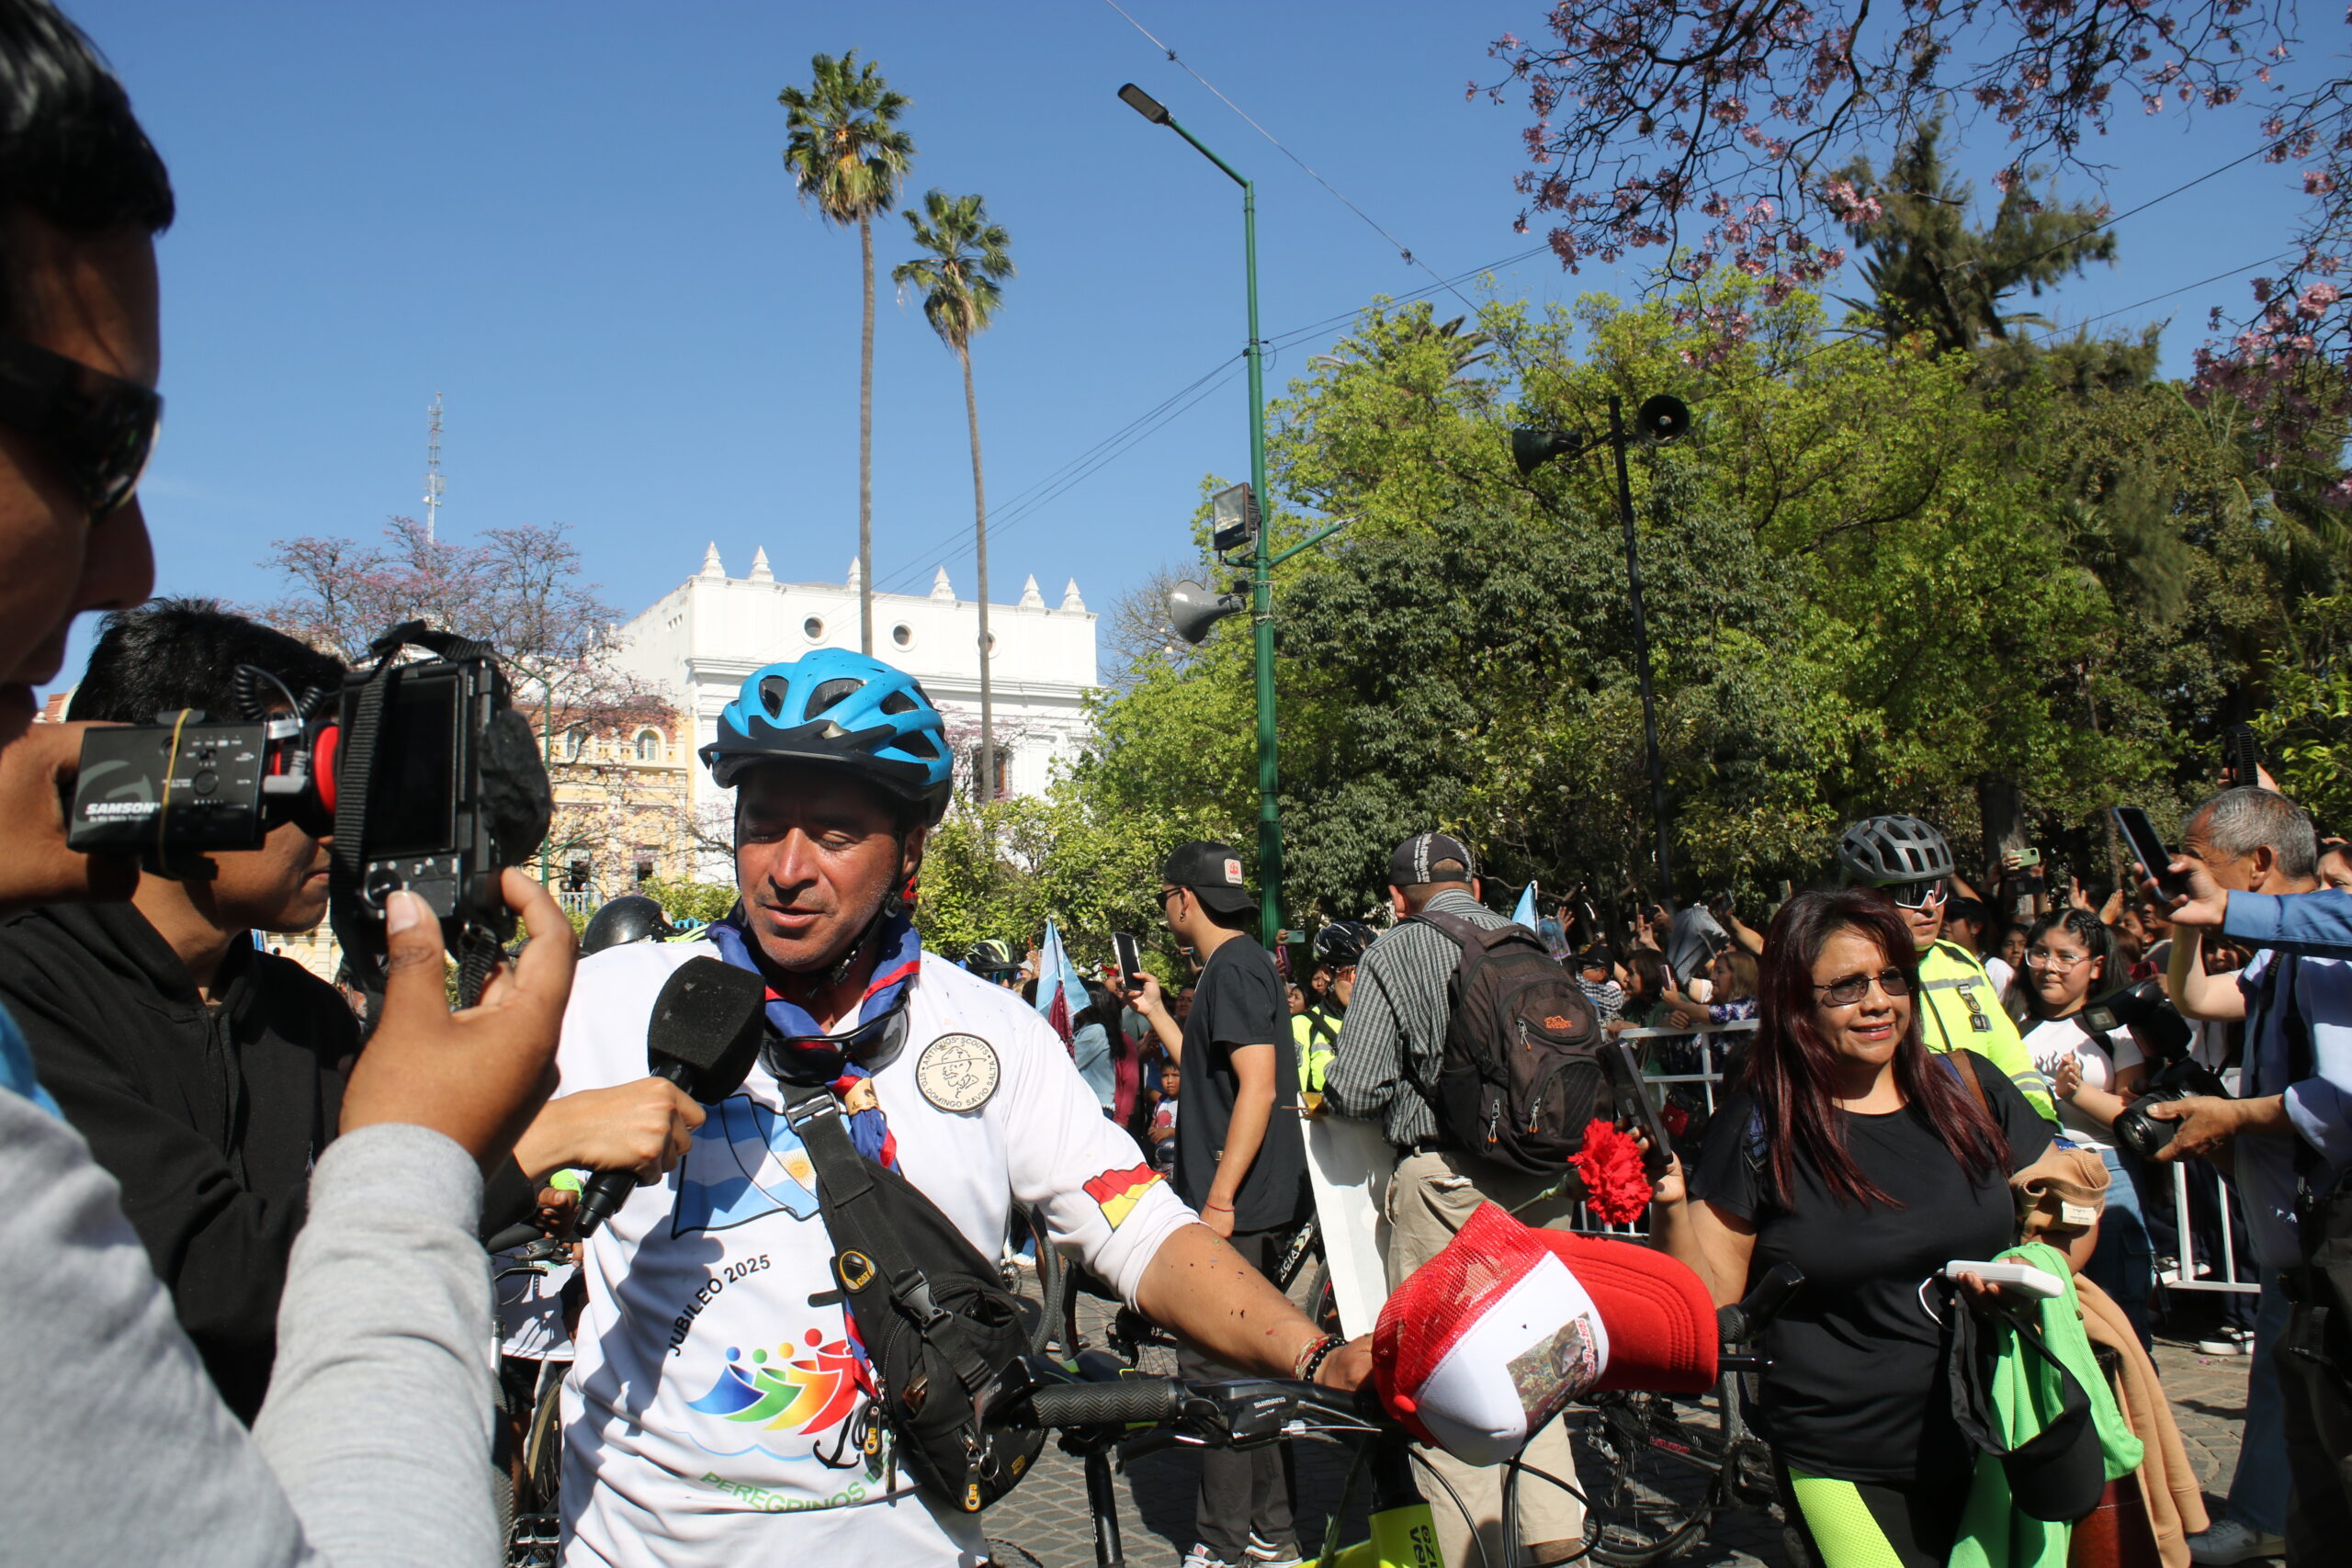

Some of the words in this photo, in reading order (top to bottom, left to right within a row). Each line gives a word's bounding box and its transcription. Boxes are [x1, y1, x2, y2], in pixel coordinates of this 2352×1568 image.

[85, 801, 155, 816] SAMSON
[960, 1036, 989, 1055] SCOUTS
[925, 1088, 963, 1108] DOMINGO
[966, 1088, 989, 1106] SAVIO
[986, 1060, 997, 1087] SALTA
[856, 1270, 871, 1287] CAT
[668, 1278, 723, 1357] JUBILEO
[723, 1254, 771, 1283] 2025
[1253, 1396, 1286, 1409] SHIMANO
[699, 1472, 867, 1511] PEREGRINOS
